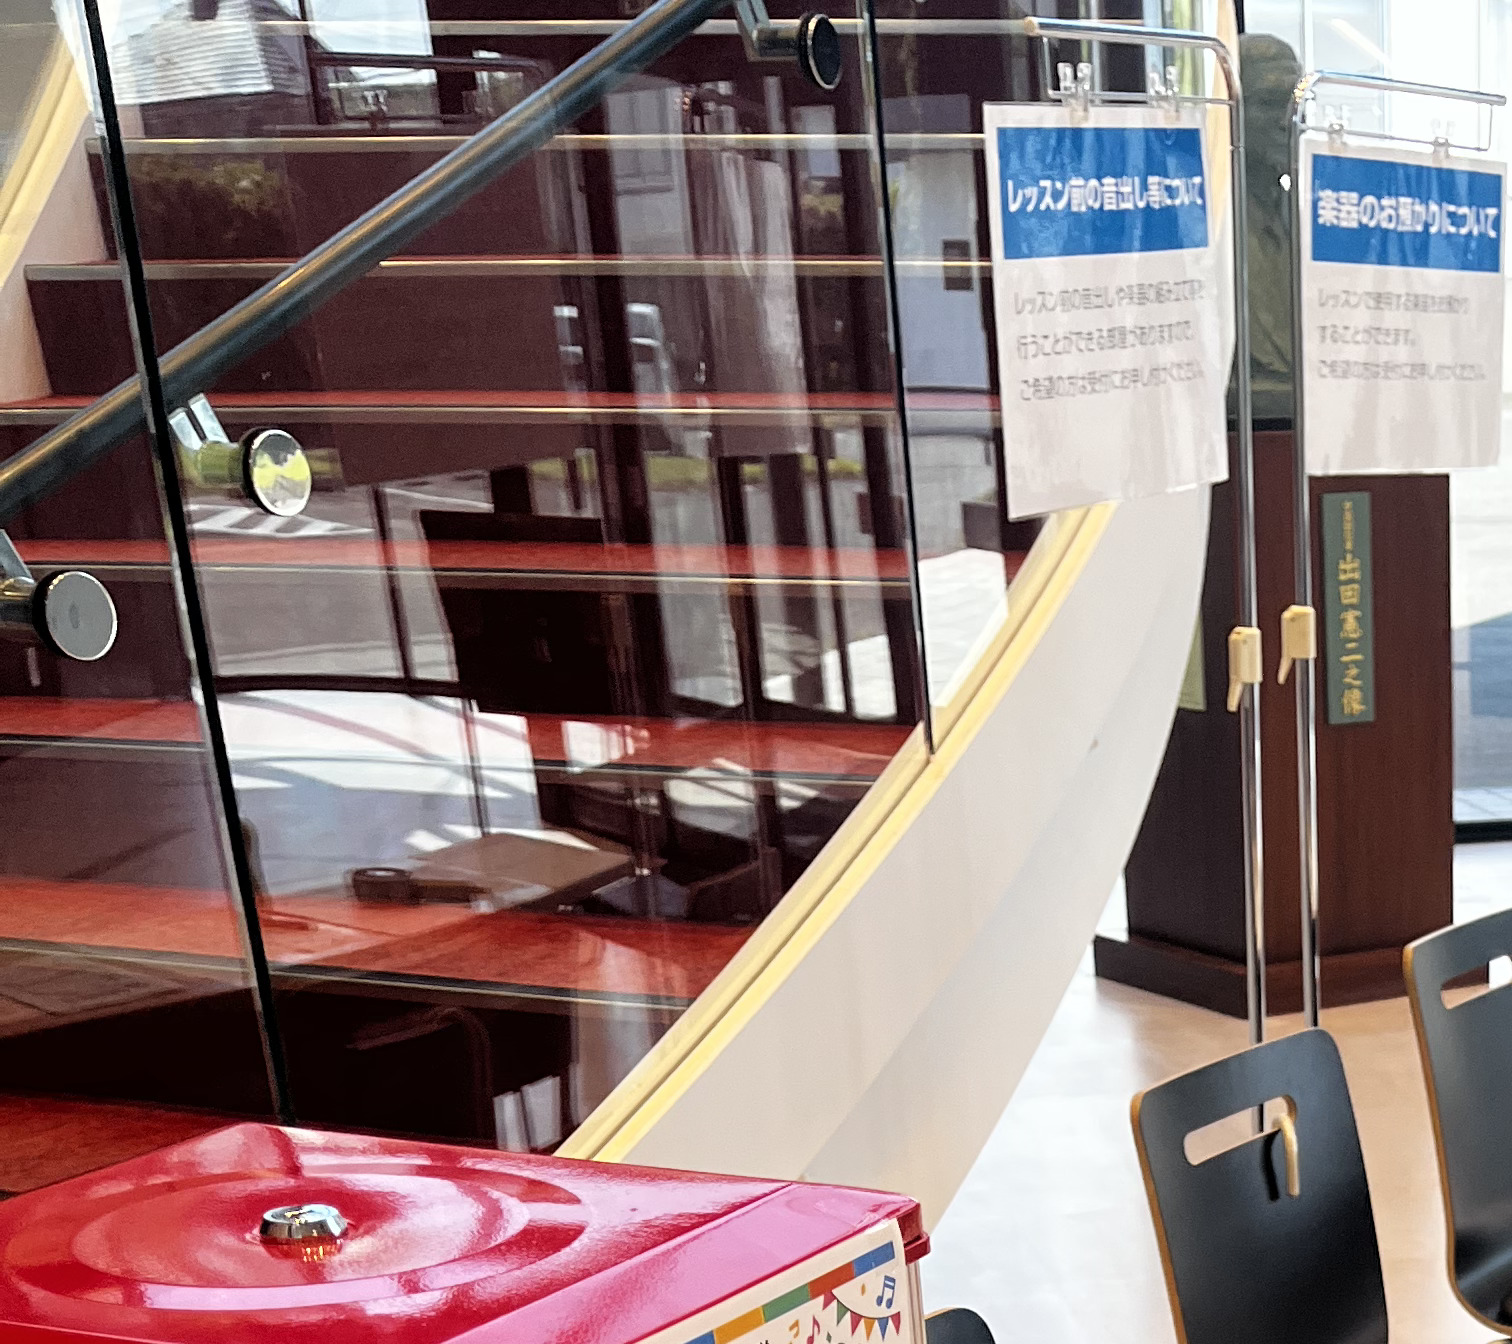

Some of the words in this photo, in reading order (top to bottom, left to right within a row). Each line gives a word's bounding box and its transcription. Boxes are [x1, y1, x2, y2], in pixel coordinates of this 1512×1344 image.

[1007, 175, 1203, 212] レッスン前の音出し等について
[1317, 189, 1499, 238] 楽器のお預かりについて
